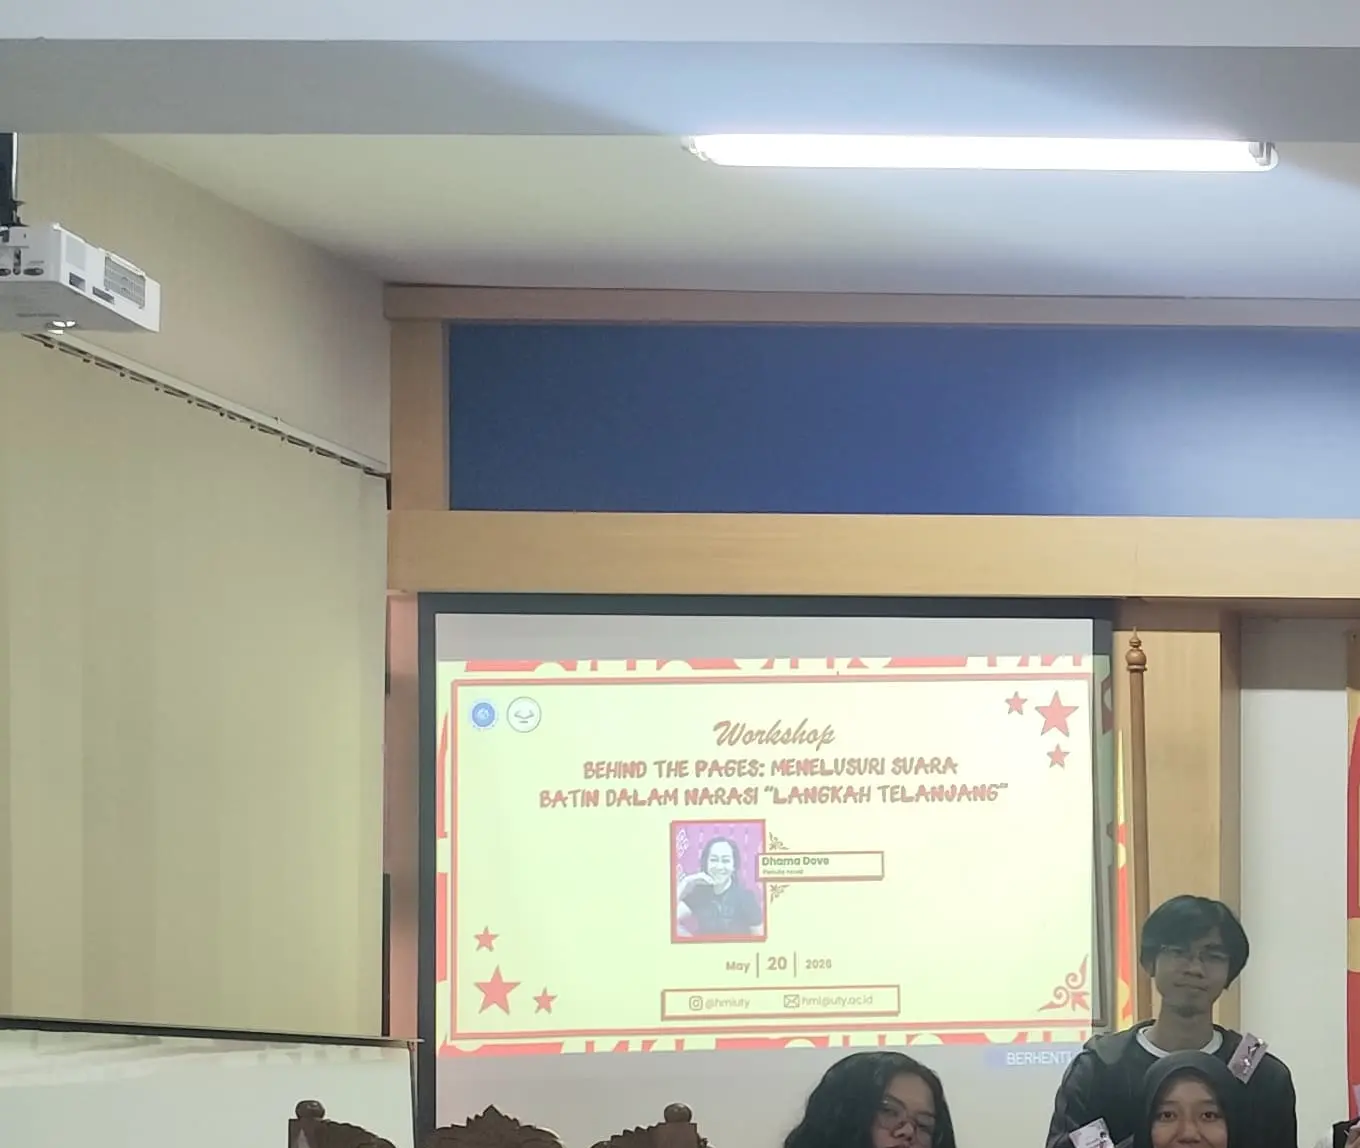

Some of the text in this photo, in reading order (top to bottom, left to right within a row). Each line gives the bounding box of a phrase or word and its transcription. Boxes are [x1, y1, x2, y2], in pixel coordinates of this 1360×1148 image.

[713, 718, 835, 751] Workshop
[583, 757, 958, 779] BEHIND THE PAGES: MENELUSURI SUARA
[539, 789, 600, 808] BATIN
[606, 788, 678, 807] DALAM
[684, 786, 758, 805] NARASI
[764, 785, 871, 805] "LANGKAH
[762, 856, 829, 866] Dhama Dove
[726, 961, 751, 974] May
[766, 956, 788, 971] 20
